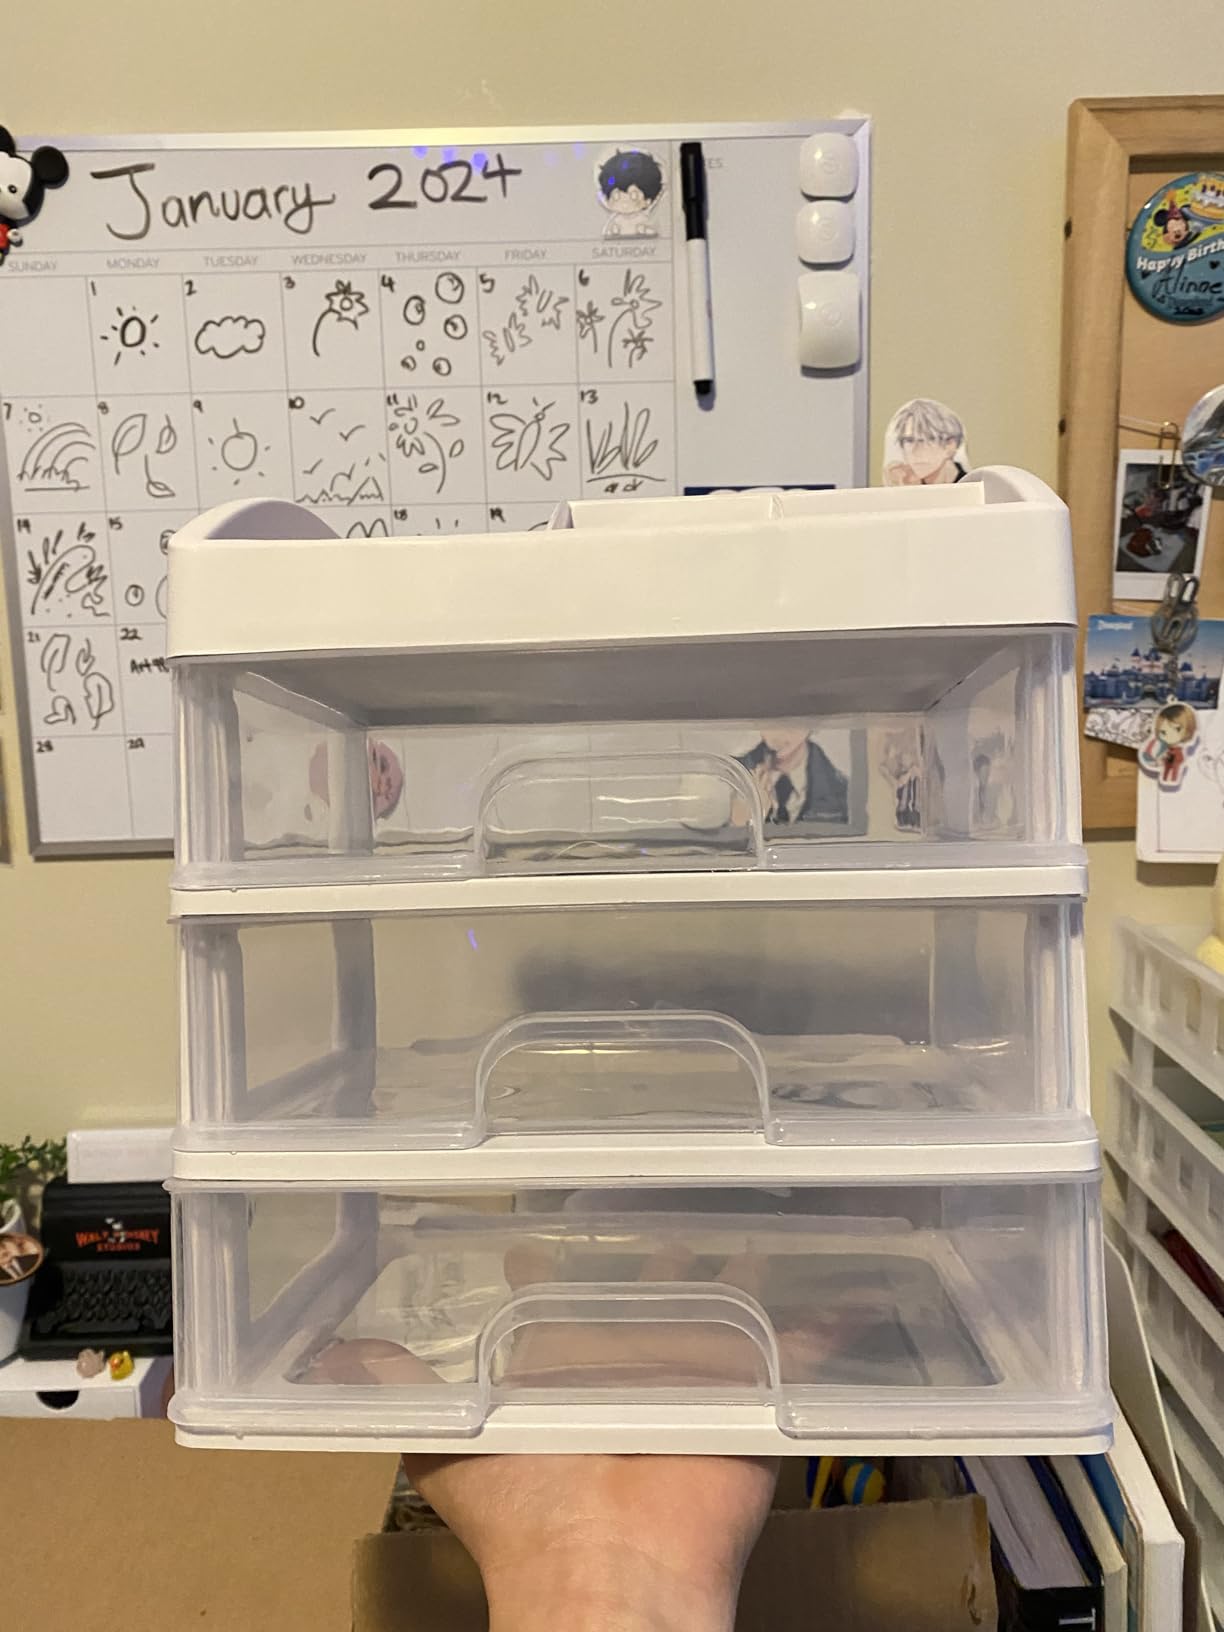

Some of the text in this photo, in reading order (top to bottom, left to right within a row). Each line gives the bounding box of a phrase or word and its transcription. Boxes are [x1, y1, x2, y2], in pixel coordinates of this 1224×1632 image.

[90, 152, 523, 241] January 2024
[7, 246, 657, 273] SUNDAY MONDAY TUESDAY WEDNESDAY THURSDAY FRIDAY SATURDAY
[283, 275, 296, 290] 3
[381, 275, 395, 293] 4
[479, 273, 496, 294] 5
[577, 268, 590, 287] 6
[90, 280, 97, 297] 1
[184, 279, 197, 297] 2
[287, 396, 305, 410] 10
[486, 391, 508, 406] 12
[579, 389, 599, 403] 13
[3, 402, 13, 421] 7
[97, 401, 110, 415] 8
[193, 400, 204, 413] 9
[16, 518, 31, 534] 14
[107, 516, 124, 531] 15
[119, 627, 143, 641] 22
